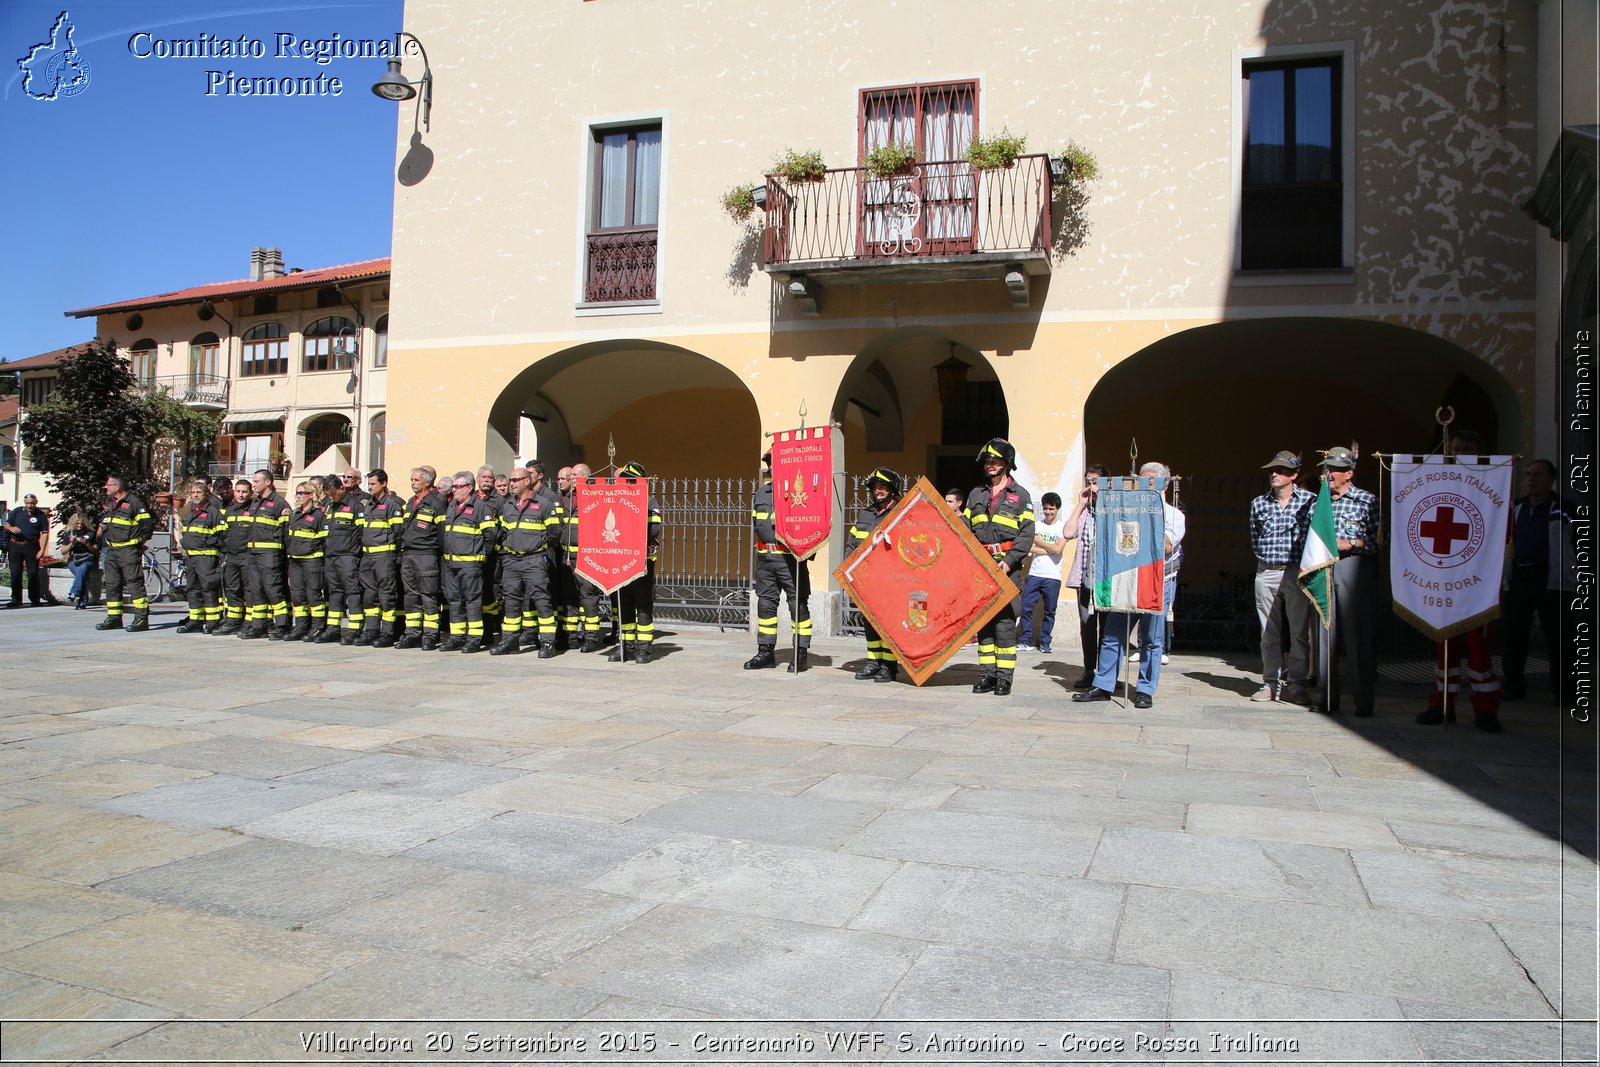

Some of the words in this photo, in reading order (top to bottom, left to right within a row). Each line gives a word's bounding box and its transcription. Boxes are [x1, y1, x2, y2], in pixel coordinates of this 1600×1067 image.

[1394, 477, 1424, 504] CROCE
[1426, 471, 1463, 483] ROSSA
[1464, 475, 1504, 509] ITALIANA
[1105, 494, 1121, 502] PRO
[1136, 494, 1156, 502] LOCO
[1423, 499, 1432, 507] DI
[1431, 495, 1466, 507] GINEVRA
[620, 498, 640, 513] FUOCO
[1464, 503, 1475, 514] 22
[1409, 504, 1425, 556] CONVENZIONE
[1471, 512, 1483, 546] AGOSTO
[581, 547, 632, 555] DISTACCAMENTO
[1460, 544, 1477, 560] 1864
[1402, 569, 1440, 591] VILLAR
[1444, 575, 1482, 592] DORA
[1422, 595, 1453, 608] 1989
